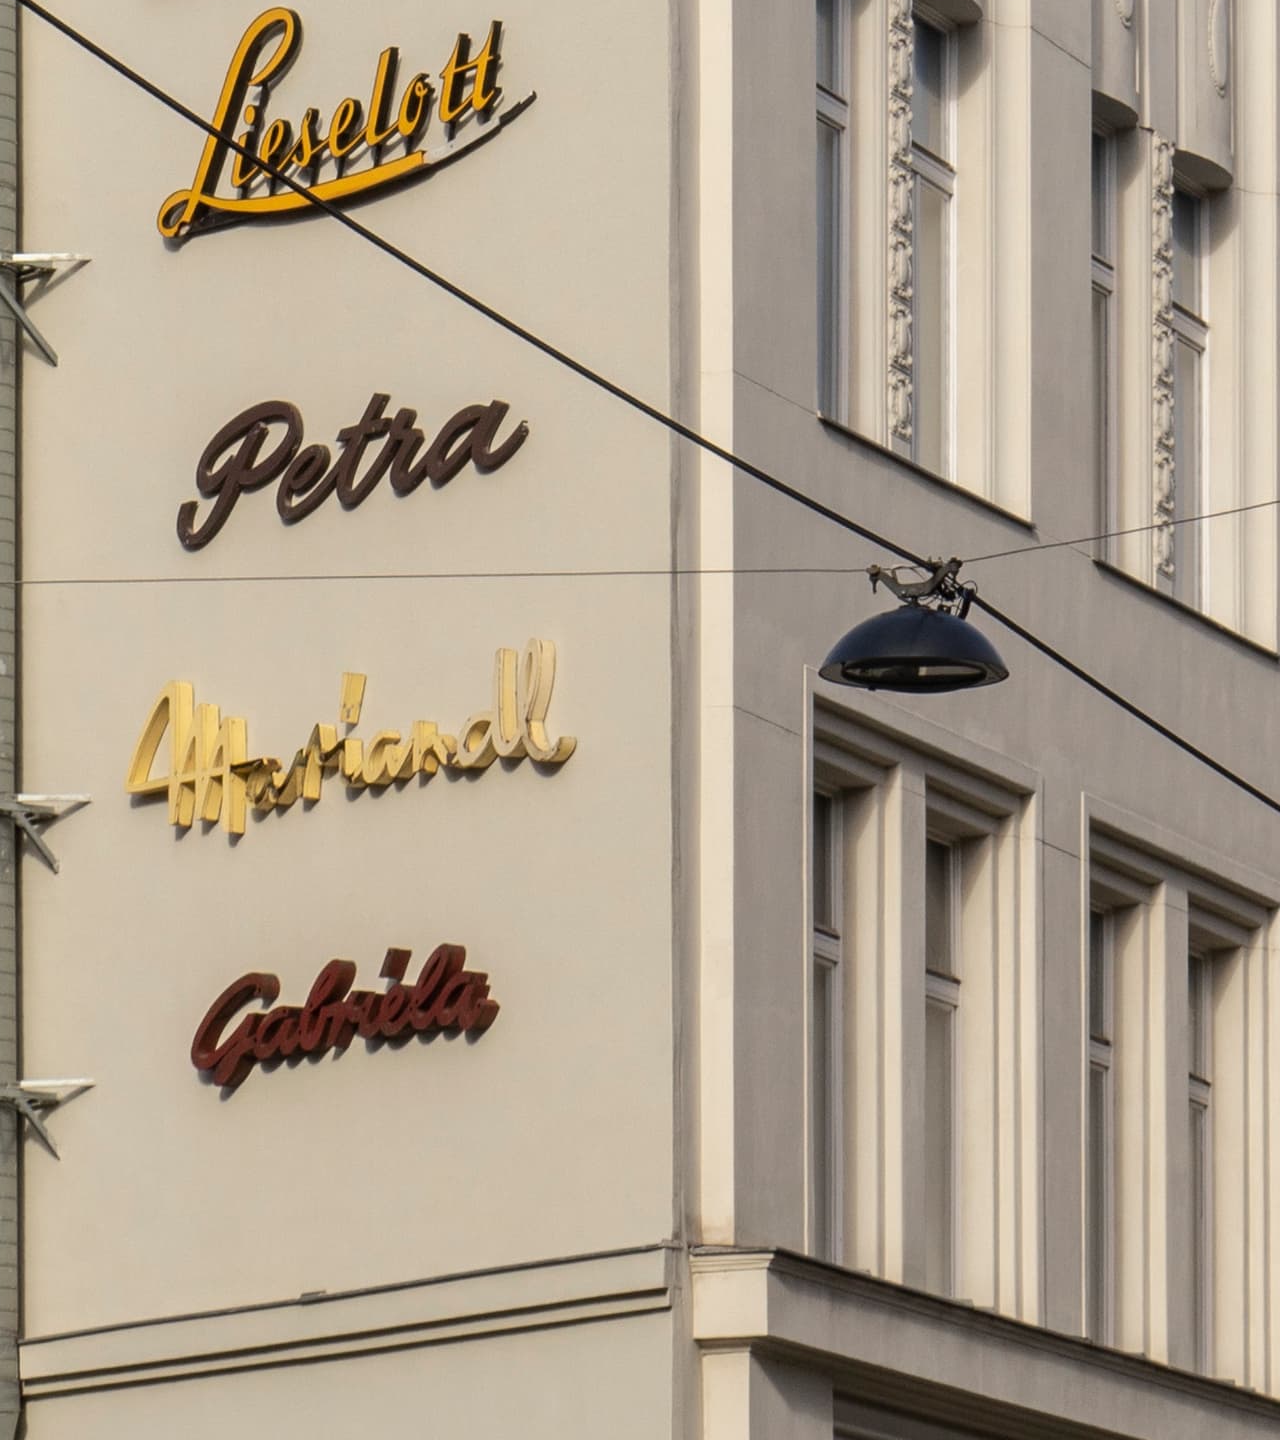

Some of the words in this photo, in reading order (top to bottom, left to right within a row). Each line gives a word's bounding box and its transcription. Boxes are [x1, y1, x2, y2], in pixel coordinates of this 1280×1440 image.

[157, 7, 537, 239] Lieselott
[176, 392, 529, 548] Petra
[125, 637, 578, 835] Mariandl
[191, 943, 500, 1087] Gabriela
